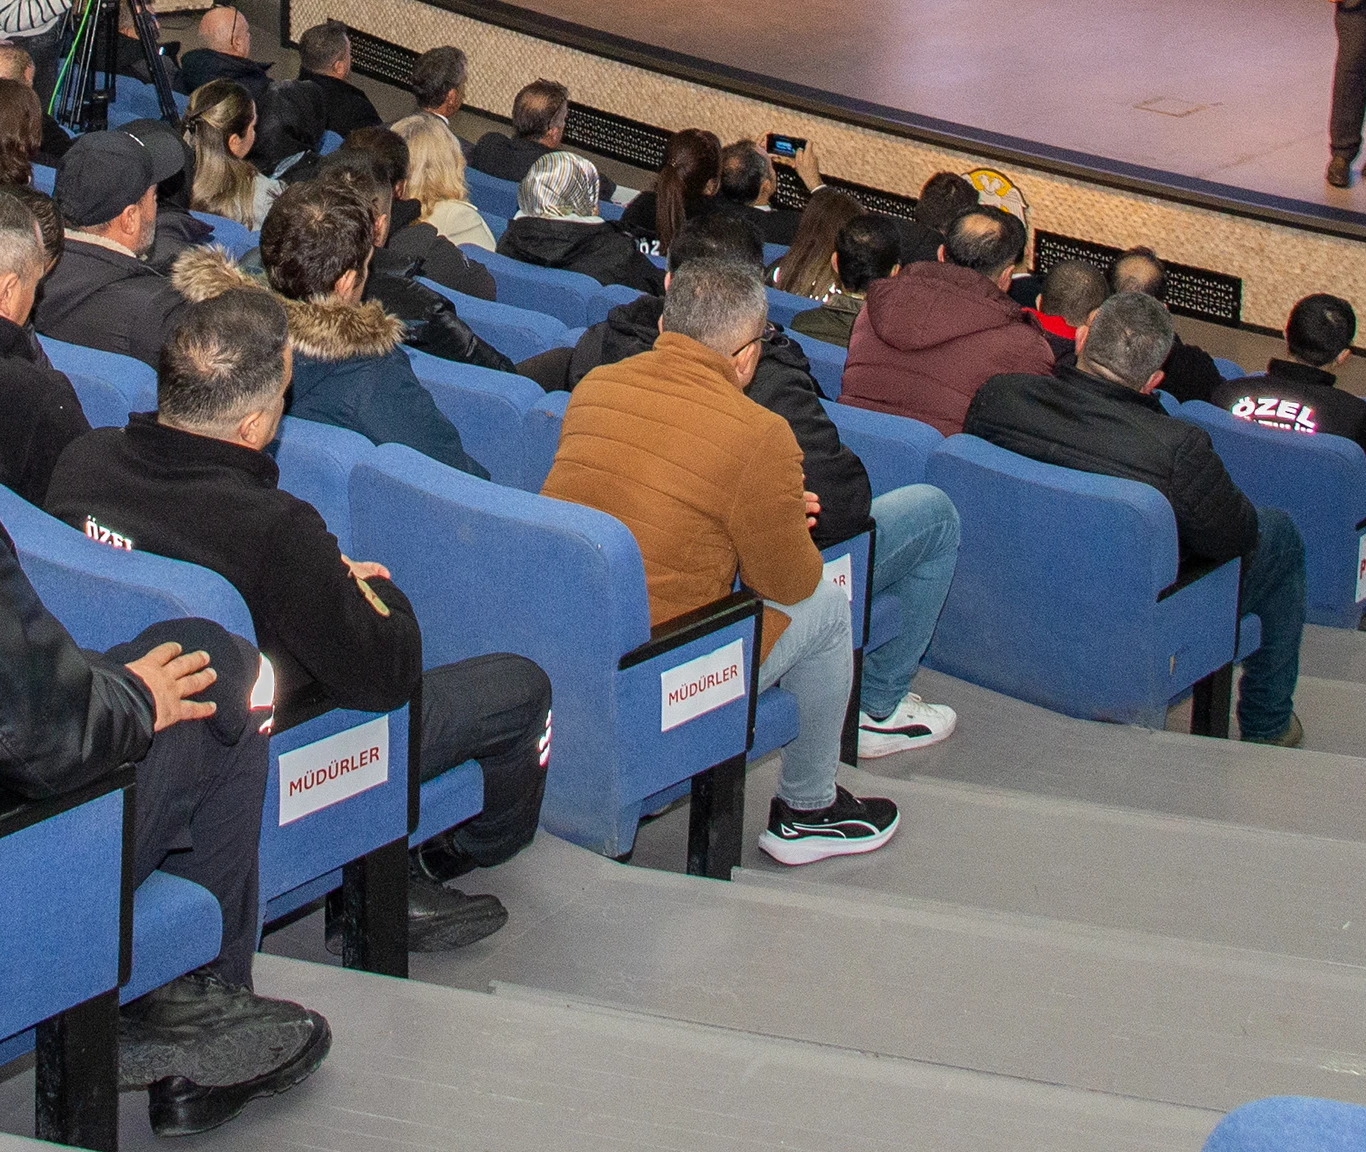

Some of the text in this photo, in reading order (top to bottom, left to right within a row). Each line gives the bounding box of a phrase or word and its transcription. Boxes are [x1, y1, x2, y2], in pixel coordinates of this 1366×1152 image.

[1231, 396, 1317, 430] ÖZEL
[668, 664, 738, 707] MÜDÜRLER
[289, 746, 380, 797] MÜDÜRLER
